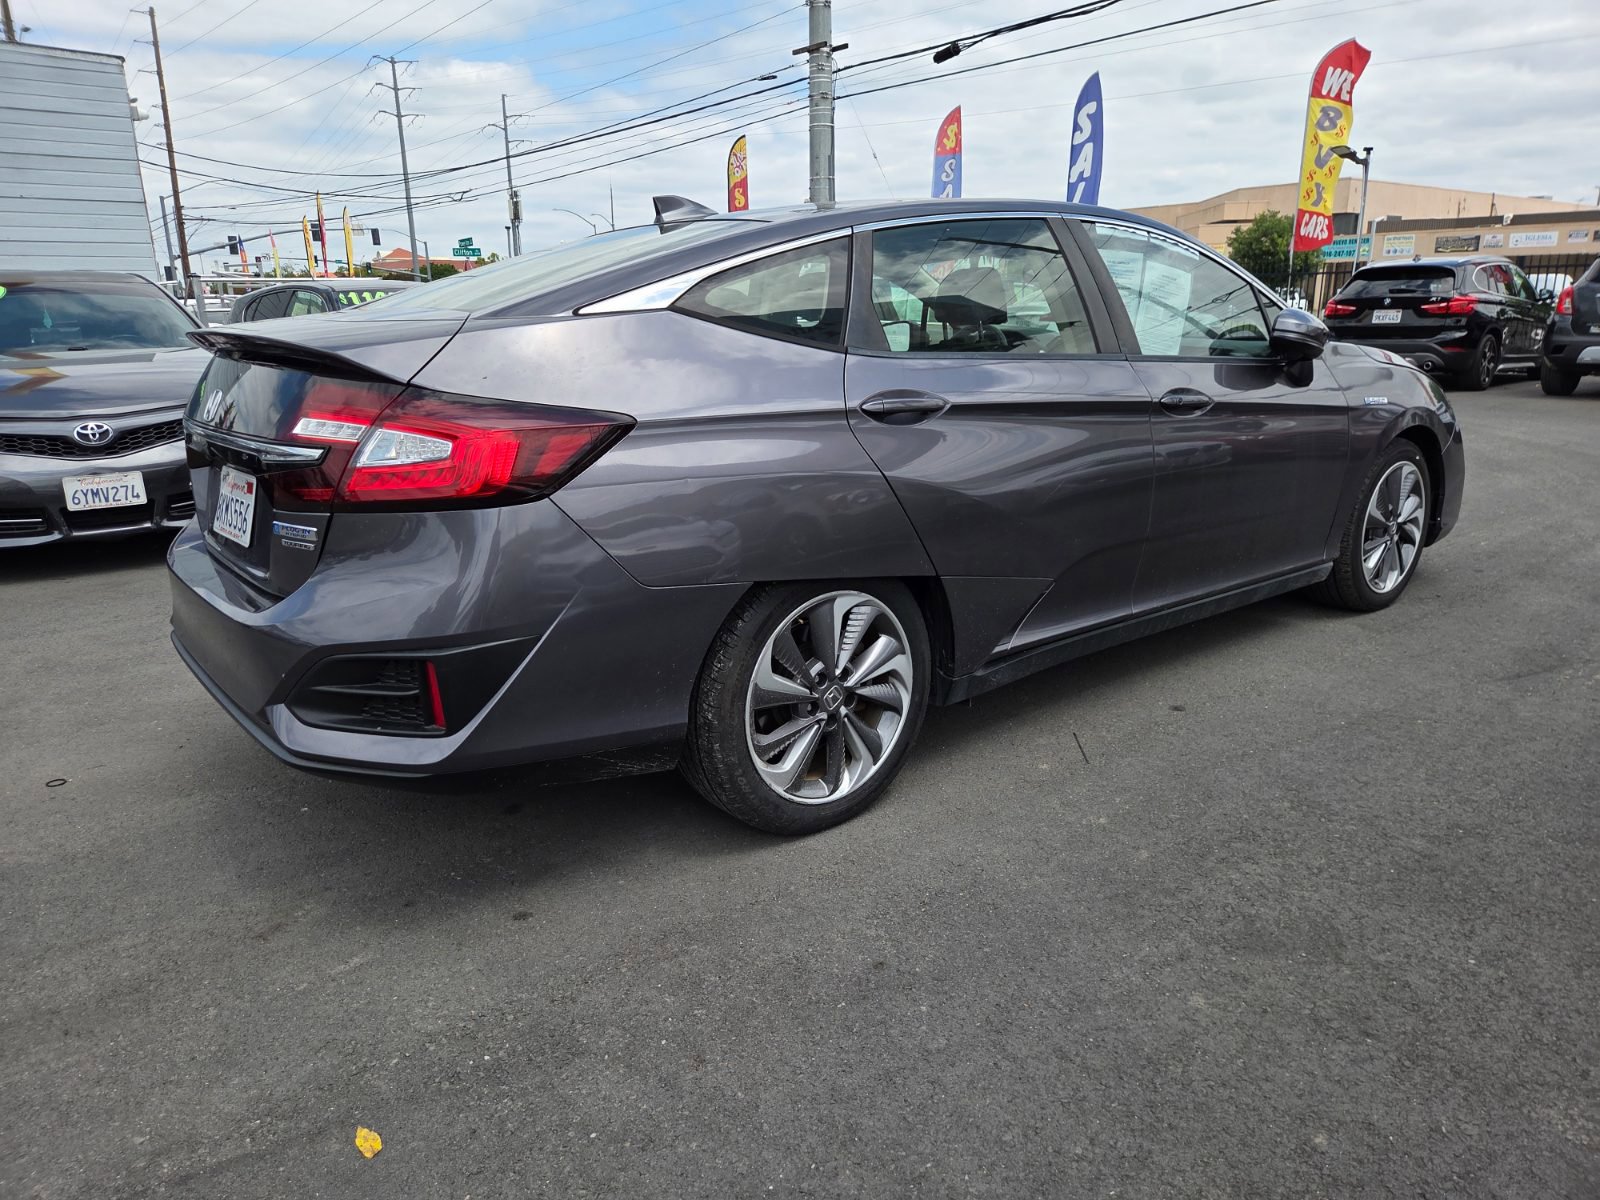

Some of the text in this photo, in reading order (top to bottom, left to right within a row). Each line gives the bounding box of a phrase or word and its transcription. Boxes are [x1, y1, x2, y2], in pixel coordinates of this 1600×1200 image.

[1321, 66, 1355, 102] WE
[1314, 105, 1343, 208] BUY
[1300, 212, 1329, 240] CARS
[71, 484, 141, 506] 6YMV274
